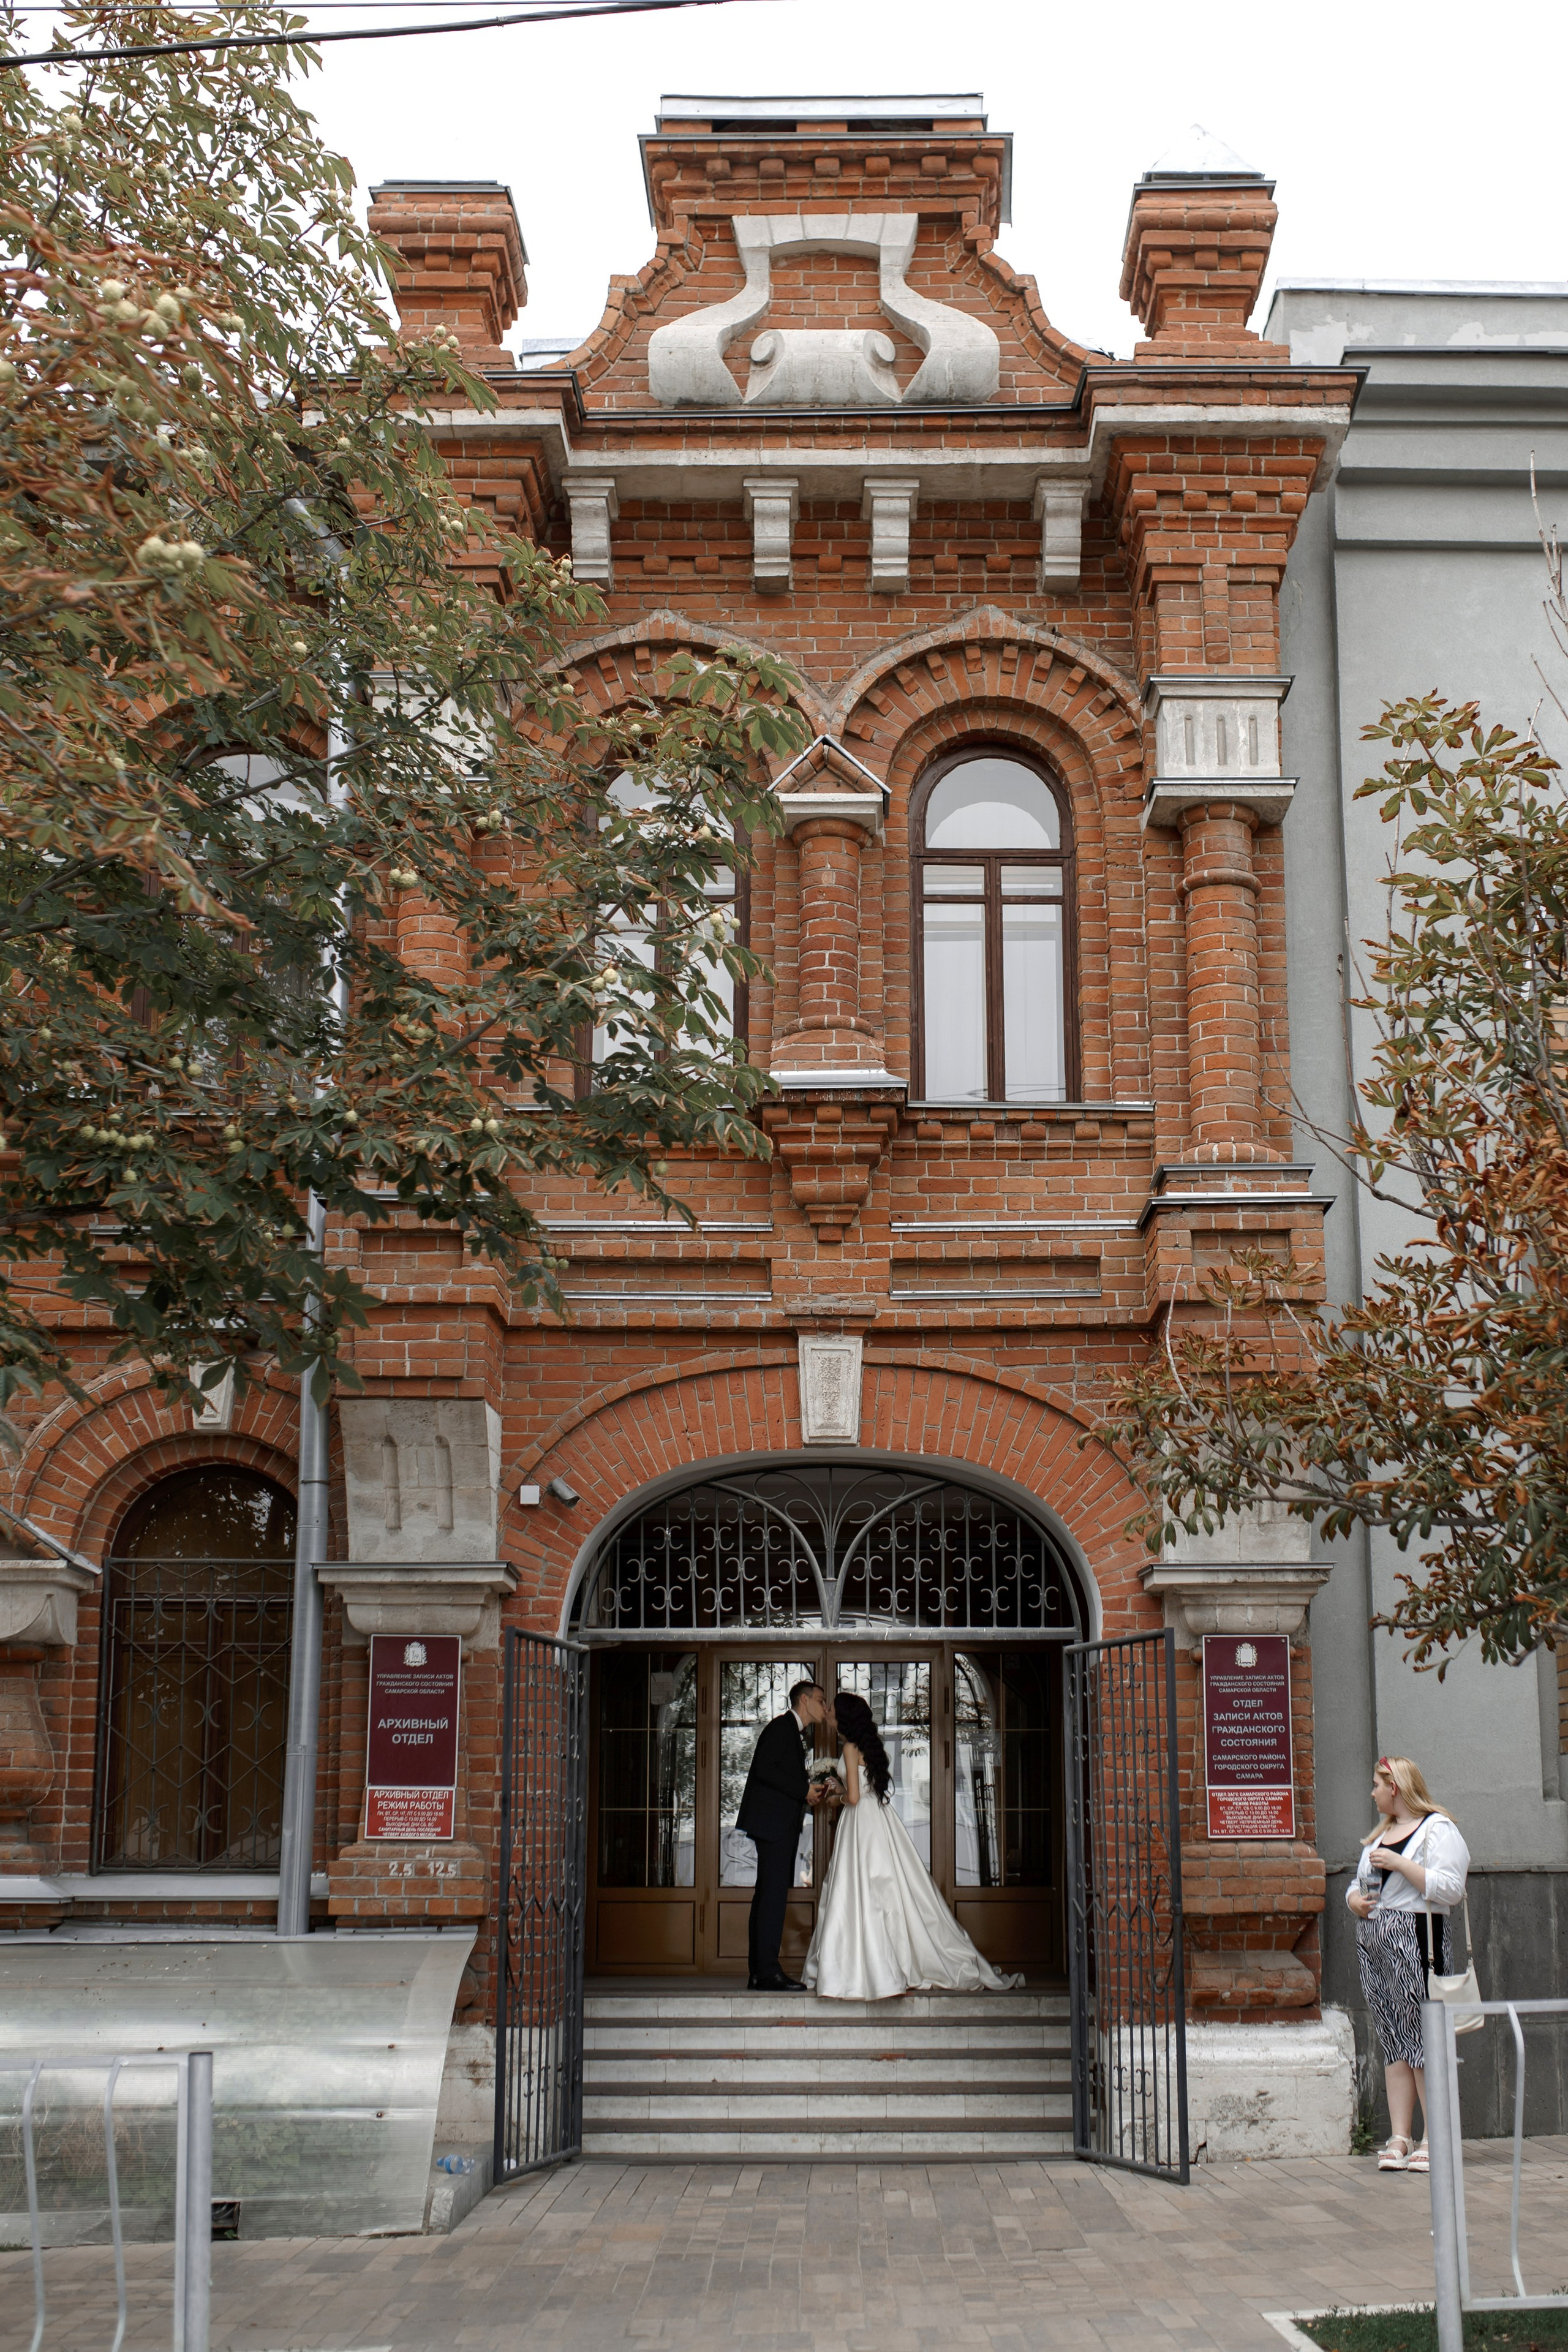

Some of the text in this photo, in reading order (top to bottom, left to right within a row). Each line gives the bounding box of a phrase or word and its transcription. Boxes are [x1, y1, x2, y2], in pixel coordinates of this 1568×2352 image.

[1233, 1700, 1263, 1708] ОТДЕЛ
[377, 1717, 448, 1729] АРХИВНЫЙ
[1212, 1725, 1285, 1735] ГРАЖДАНСКОГО
[392, 1733, 434, 1746] ОТДЕЛ
[374, 1790, 449, 1800] АРХИВНЫЙ ОТДЕЛ
[377, 1801, 444, 1810] РЕЖИМ РАБОТЫ
[389, 1861, 413, 1877] 2.5
